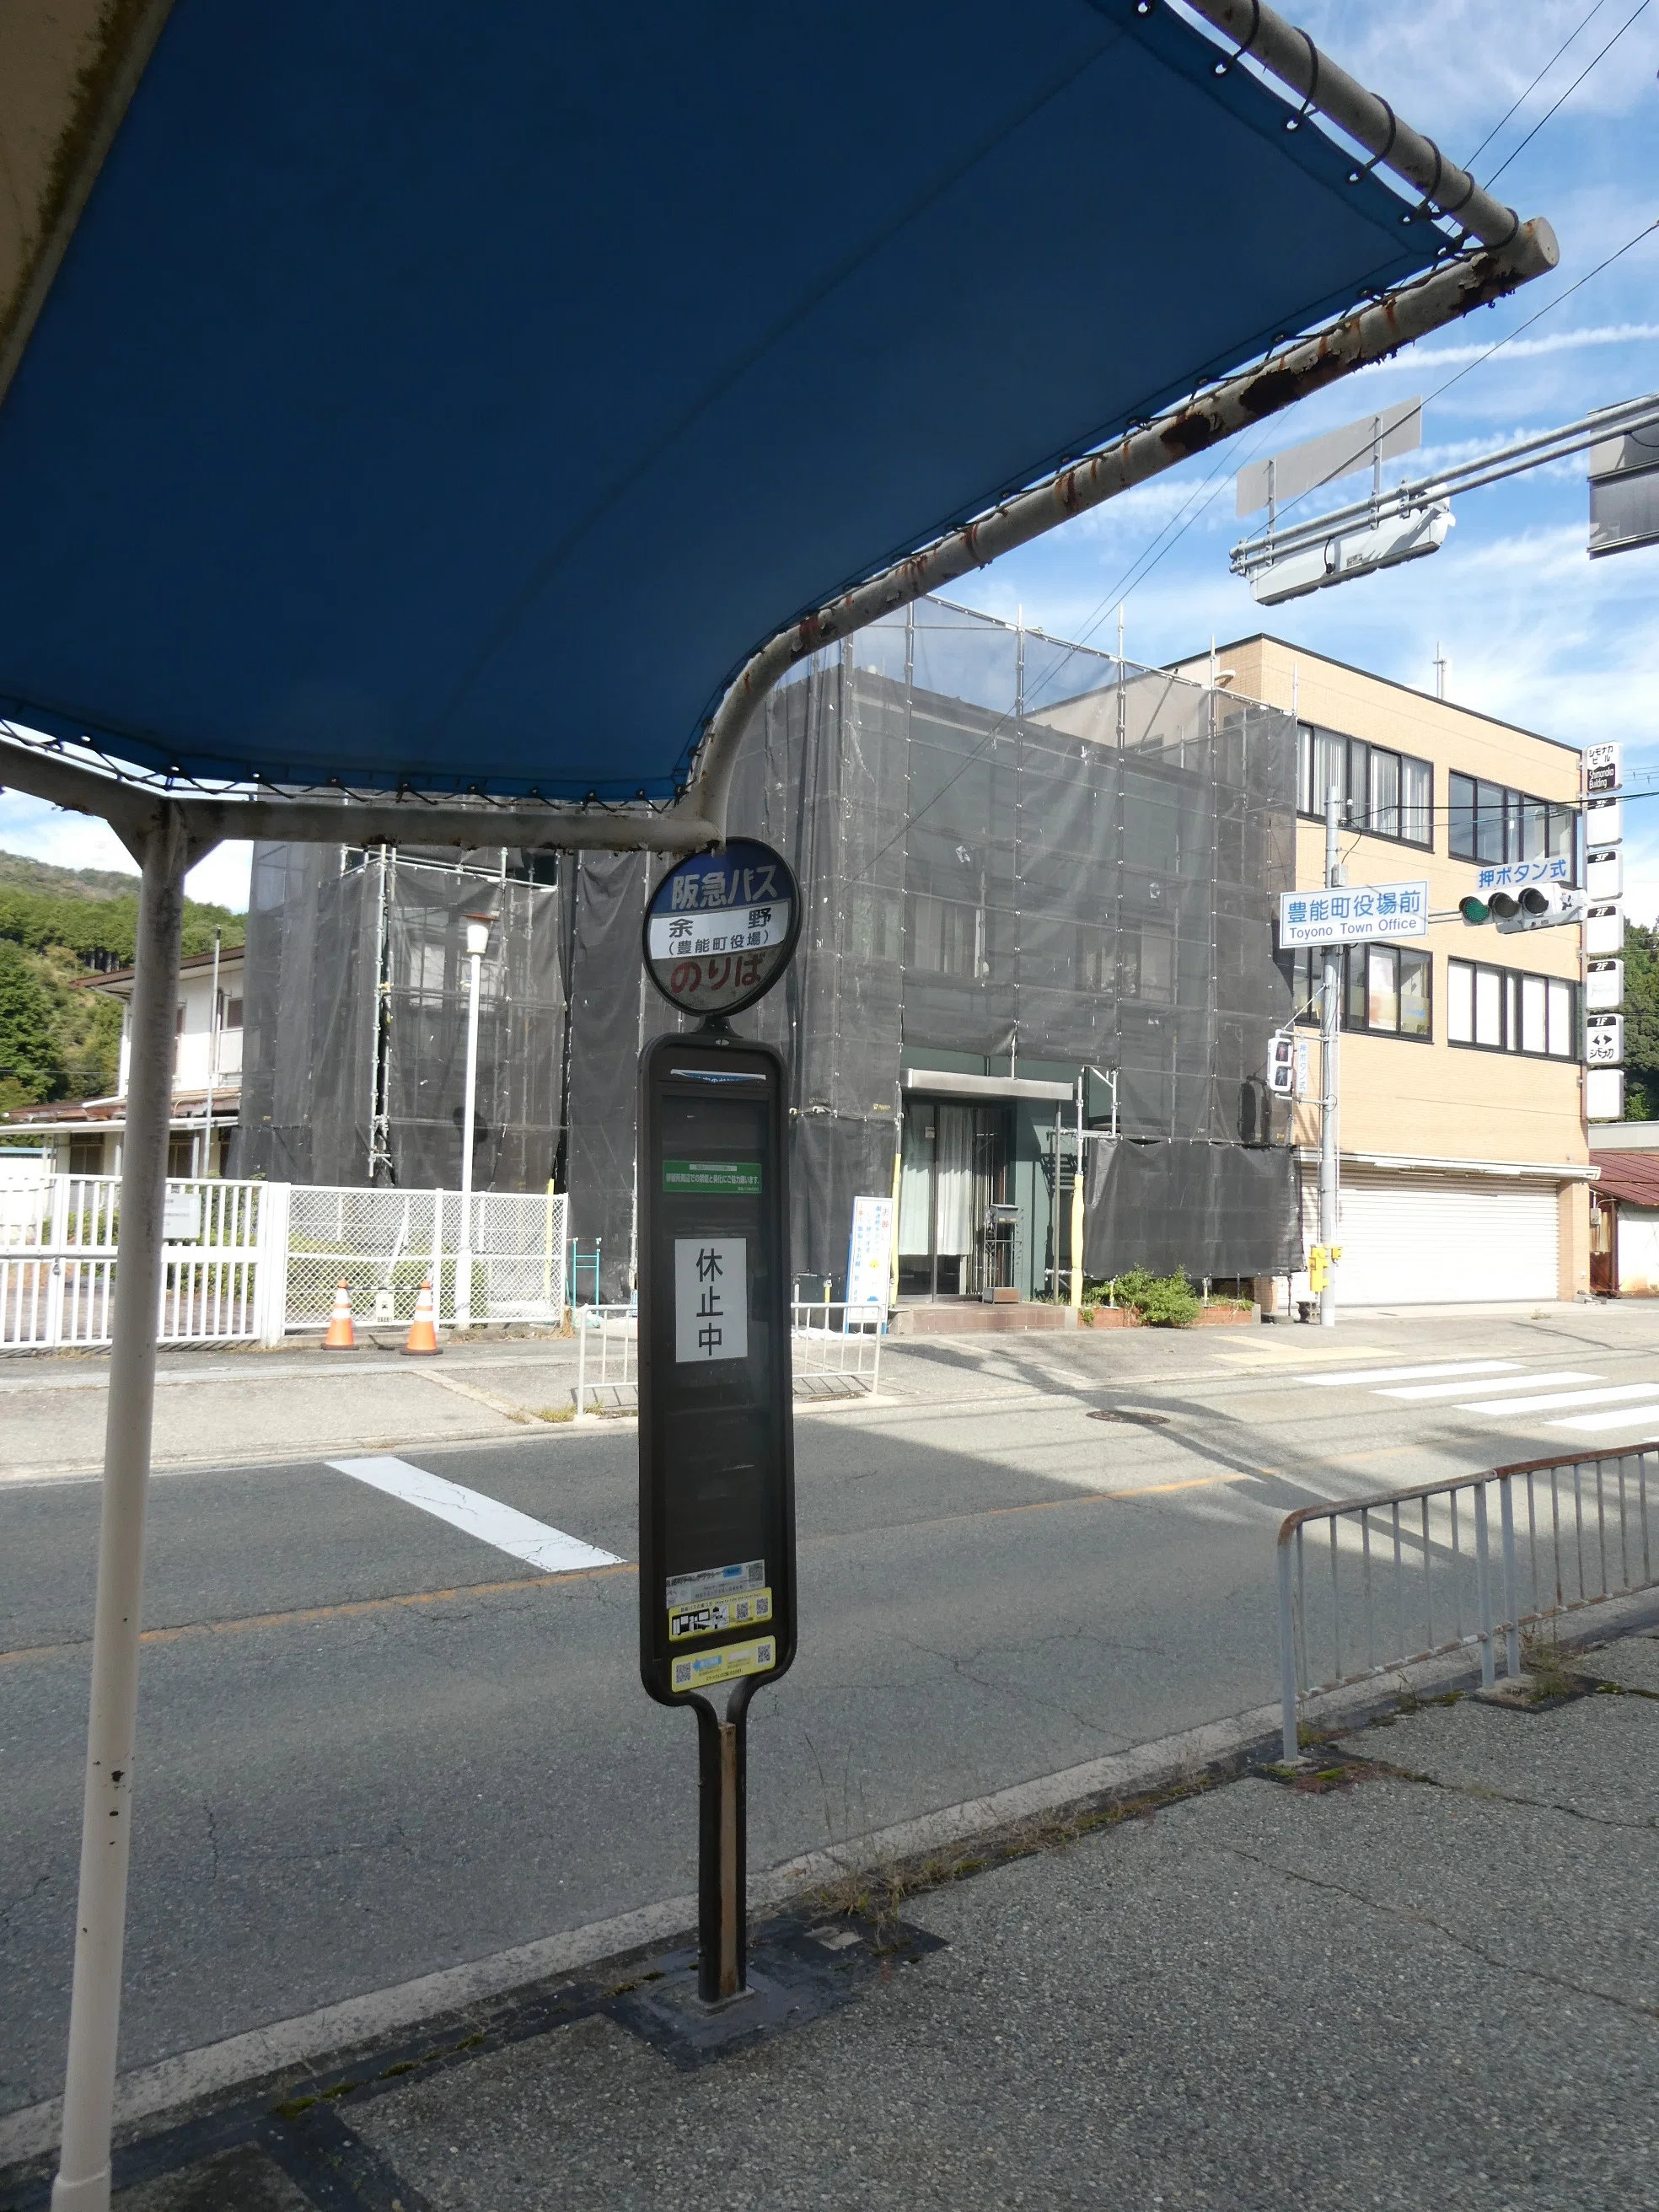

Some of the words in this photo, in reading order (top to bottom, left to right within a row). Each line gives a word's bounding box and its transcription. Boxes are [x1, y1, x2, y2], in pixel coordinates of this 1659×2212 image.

[1589, 745, 1613, 758] シモナカ
[1596, 852, 1608, 862] 3F
[1479, 859, 1566, 888] 押ボタン式
[671, 865, 778, 910] 阪急バス
[1287, 890, 1421, 924] 豊能町役場前
[1595, 907, 1608, 917] 2F
[1289, 926, 1333, 940] Toyono
[1340, 922, 1372, 935] Town
[1378, 917, 1417, 932] Office
[671, 952, 765, 993] のりば
[1595, 962, 1608, 971] 2F
[1596, 1017, 1608, 1026] 1F
[1589, 1048, 1614, 1059] シモナカ
[695, 1248, 724, 1356] 休止中
